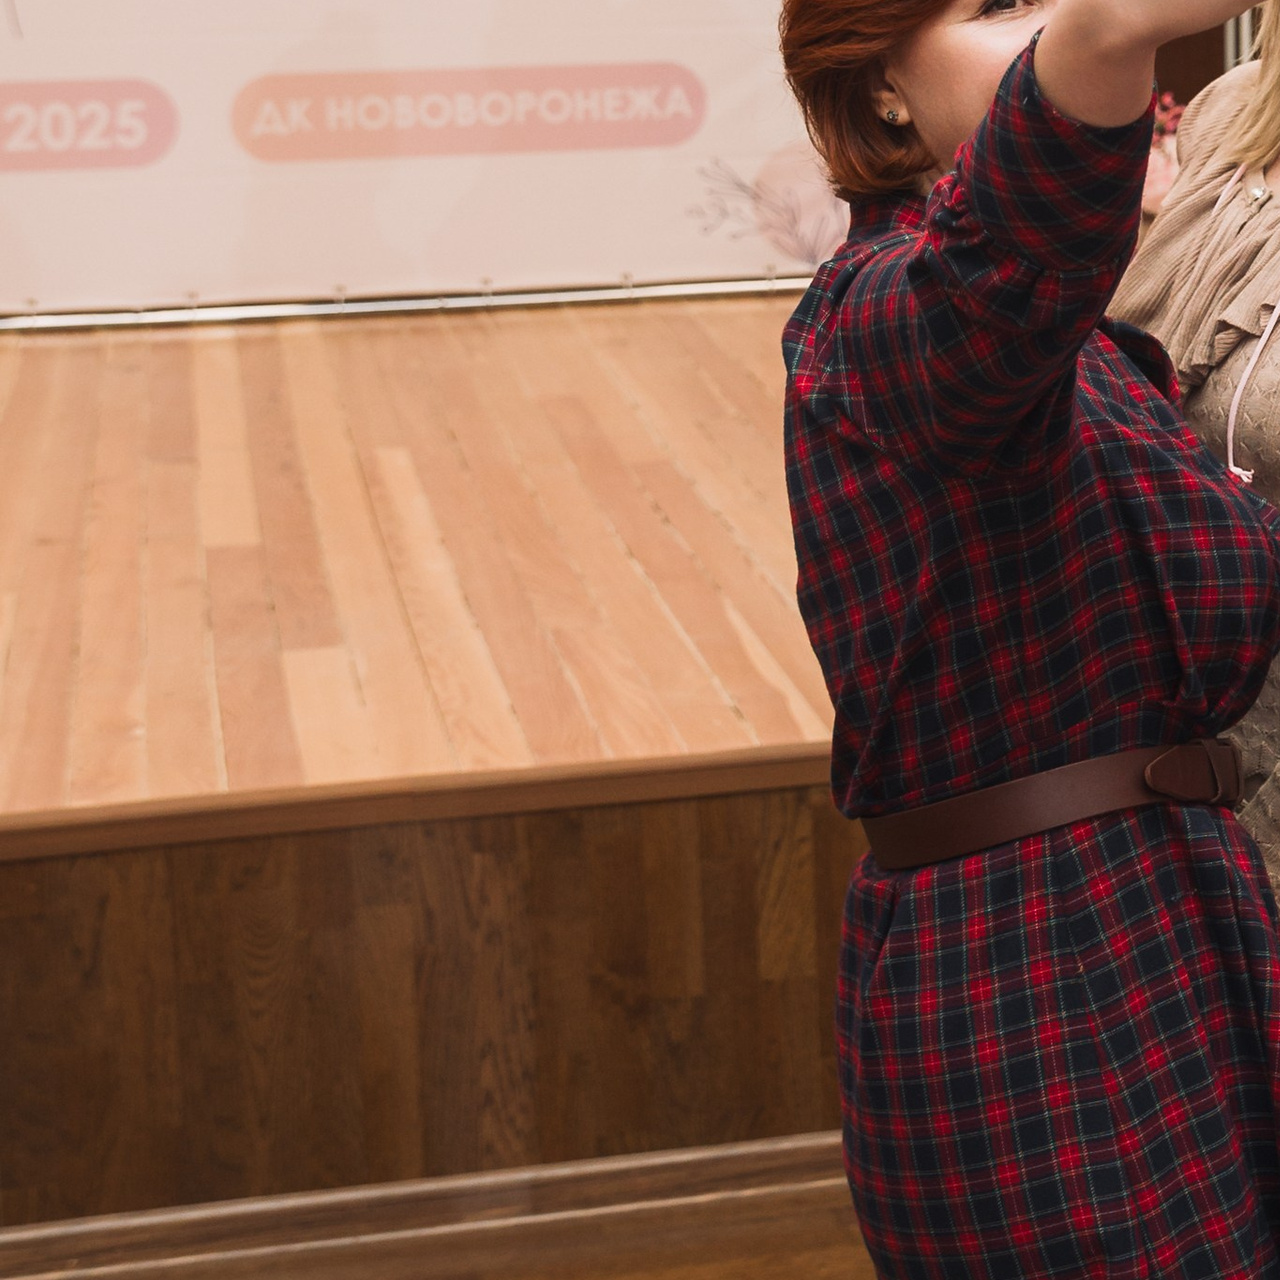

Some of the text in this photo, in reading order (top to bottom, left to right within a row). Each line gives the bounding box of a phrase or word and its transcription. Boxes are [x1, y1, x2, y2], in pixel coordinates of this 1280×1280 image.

[3, 101, 149, 152] 2025
[251, 86, 693, 137] ДК НОВОВОРОНЕЖА
